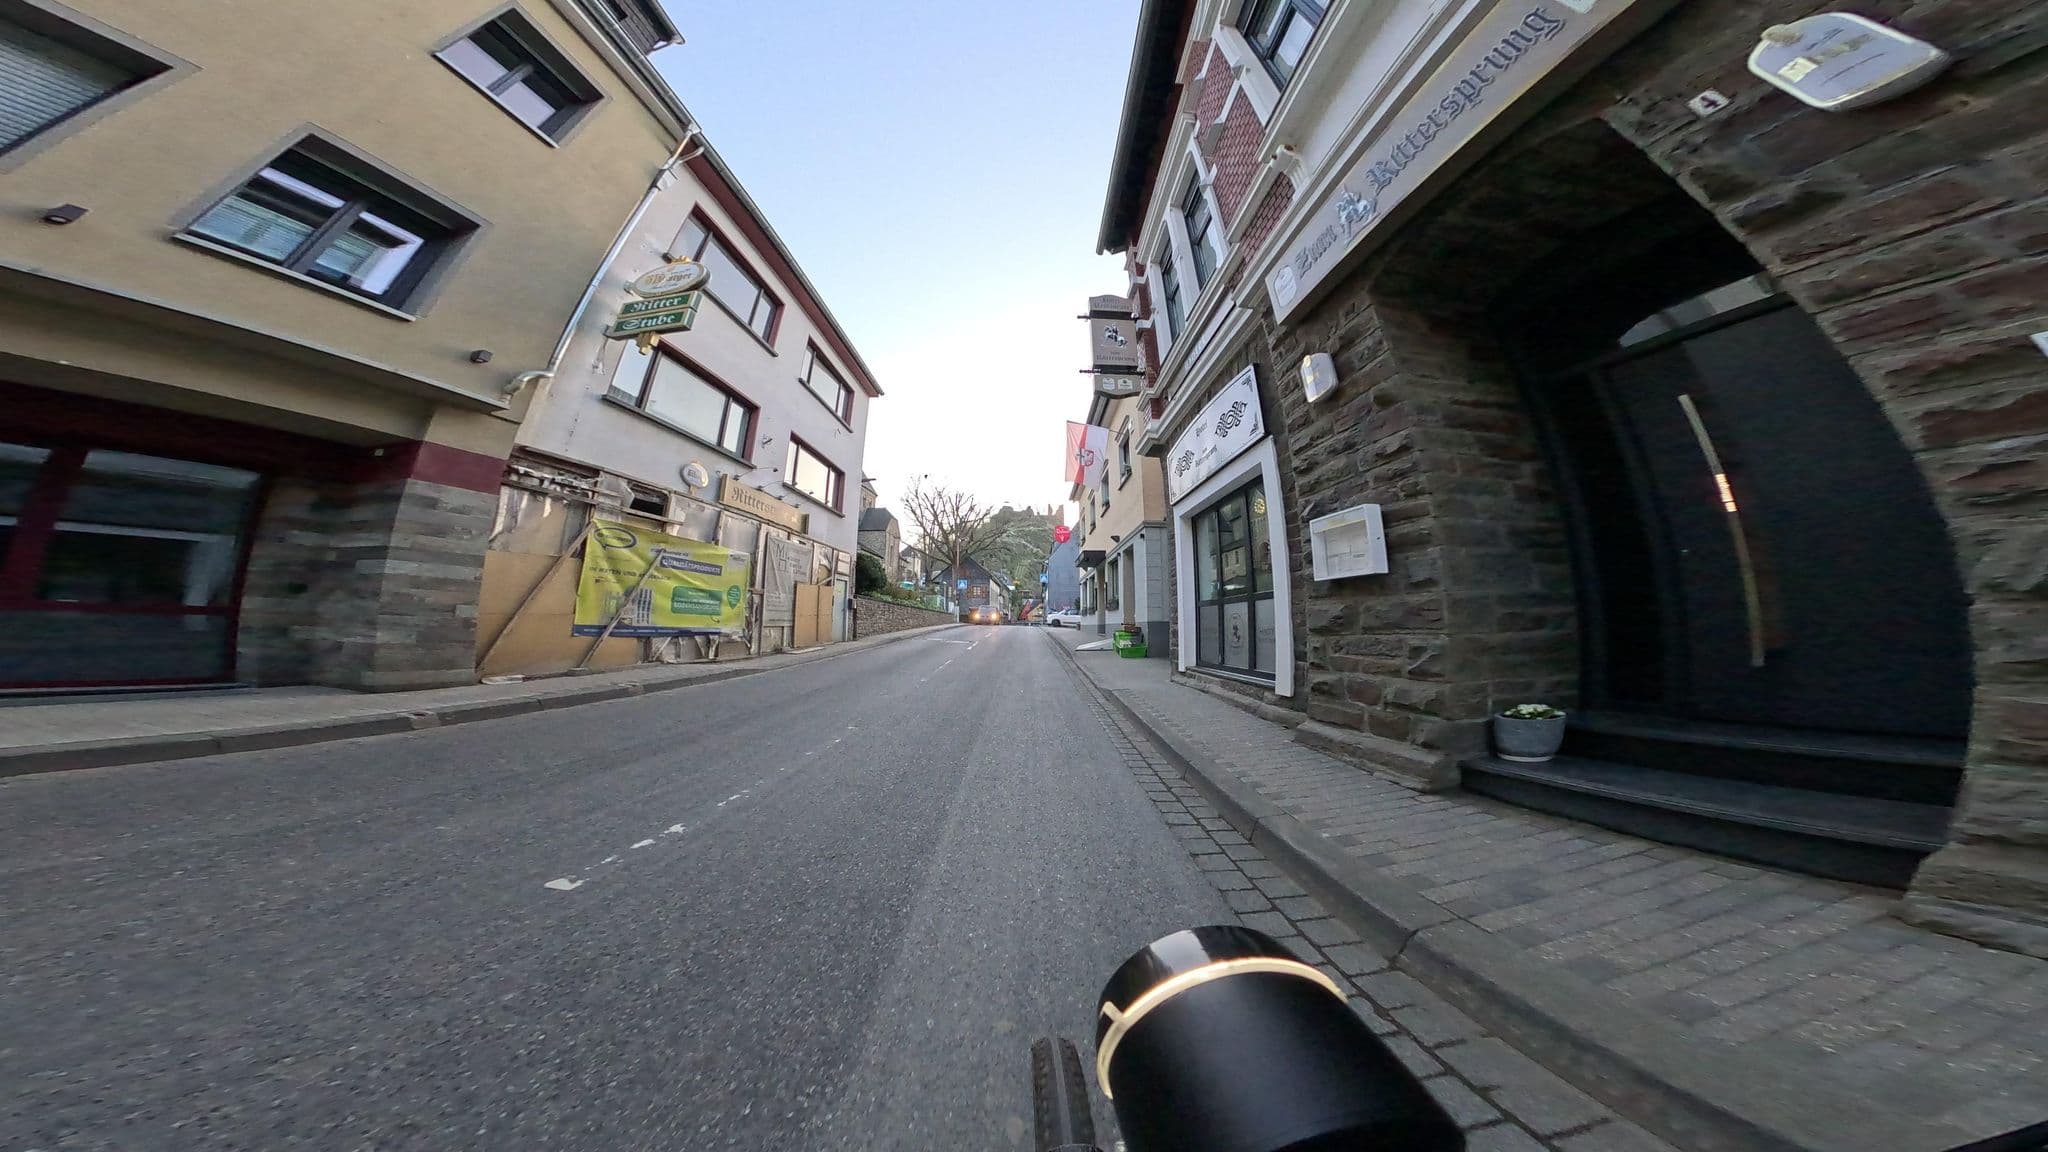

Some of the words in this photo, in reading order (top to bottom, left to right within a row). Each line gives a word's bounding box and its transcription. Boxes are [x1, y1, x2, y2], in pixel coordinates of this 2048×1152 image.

[1296, 225, 1338, 279] Zum
[1366, 7, 1565, 195] Rittersprung
[630, 297, 682, 313] Ritter
[622, 315, 676, 330] Stube
